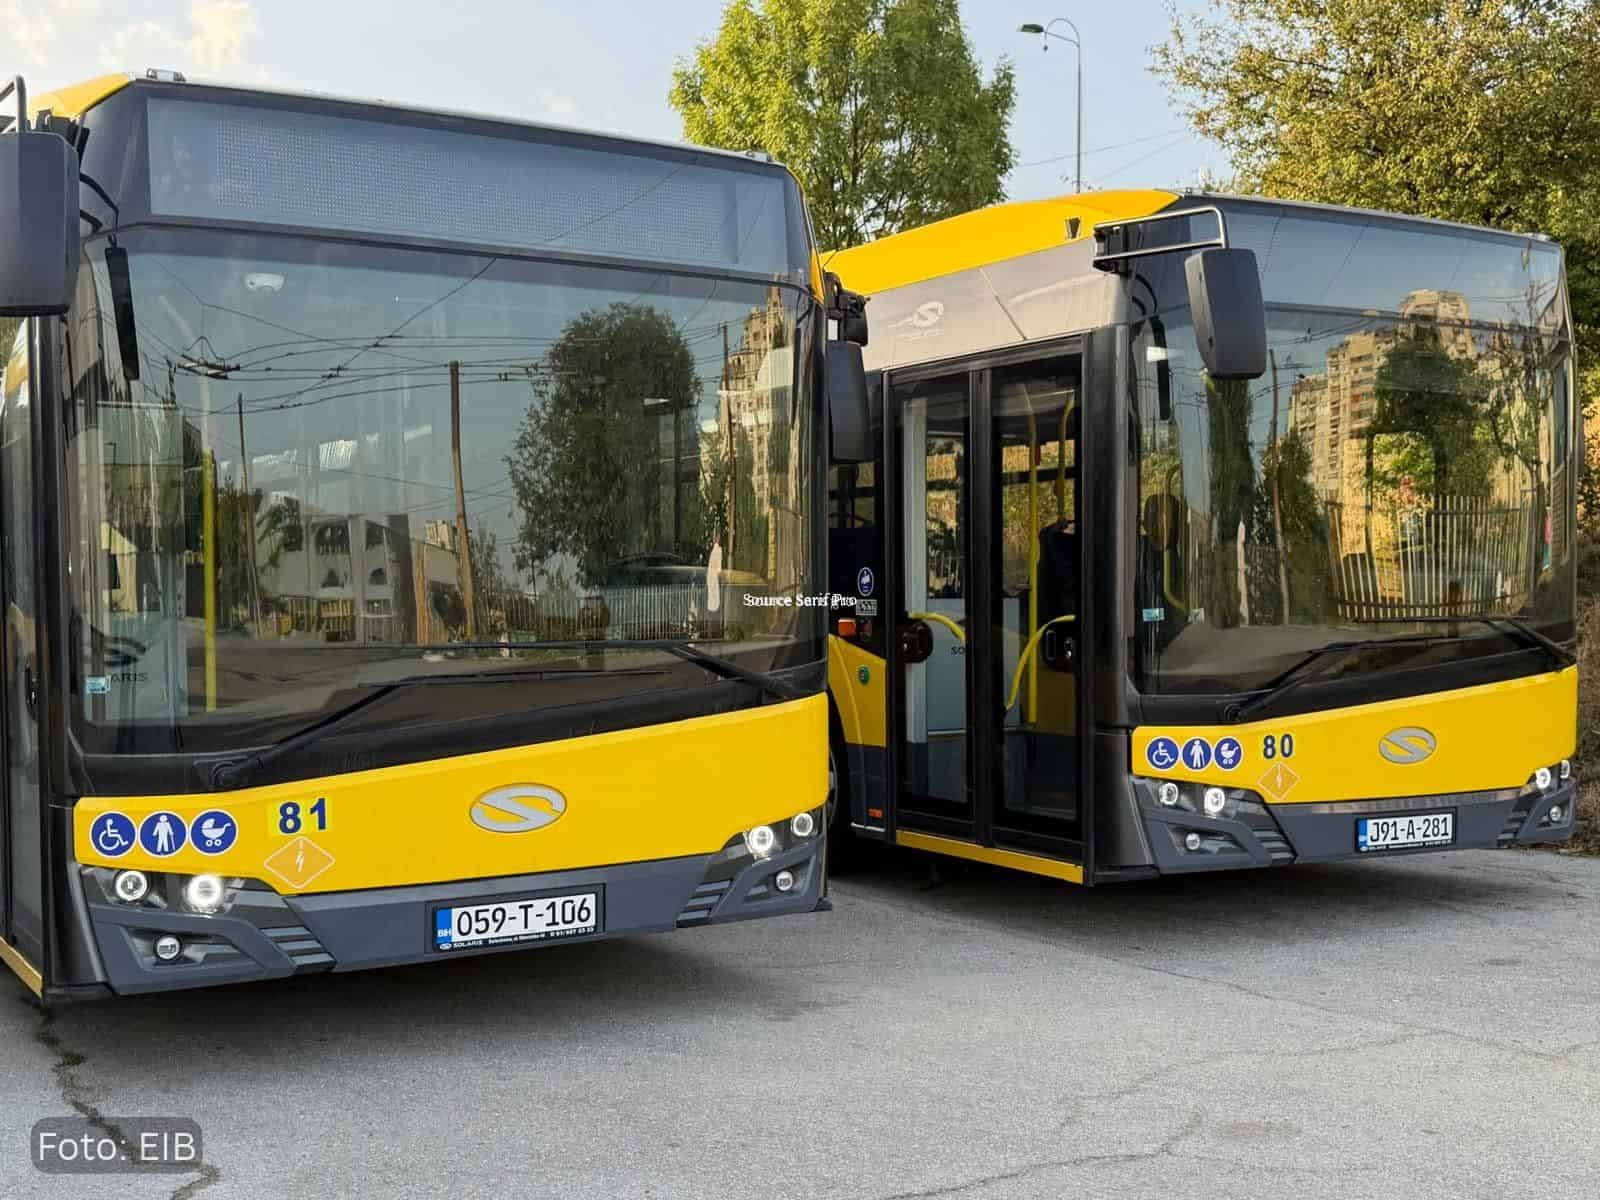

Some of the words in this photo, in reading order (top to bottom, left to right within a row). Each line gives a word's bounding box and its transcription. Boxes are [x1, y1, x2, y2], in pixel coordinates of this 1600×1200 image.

[1263, 734, 1294, 759] 80
[279, 798, 326, 834] 81
[1370, 816, 1449, 843] J91-A-281
[456, 897, 592, 937] 059-T-106
